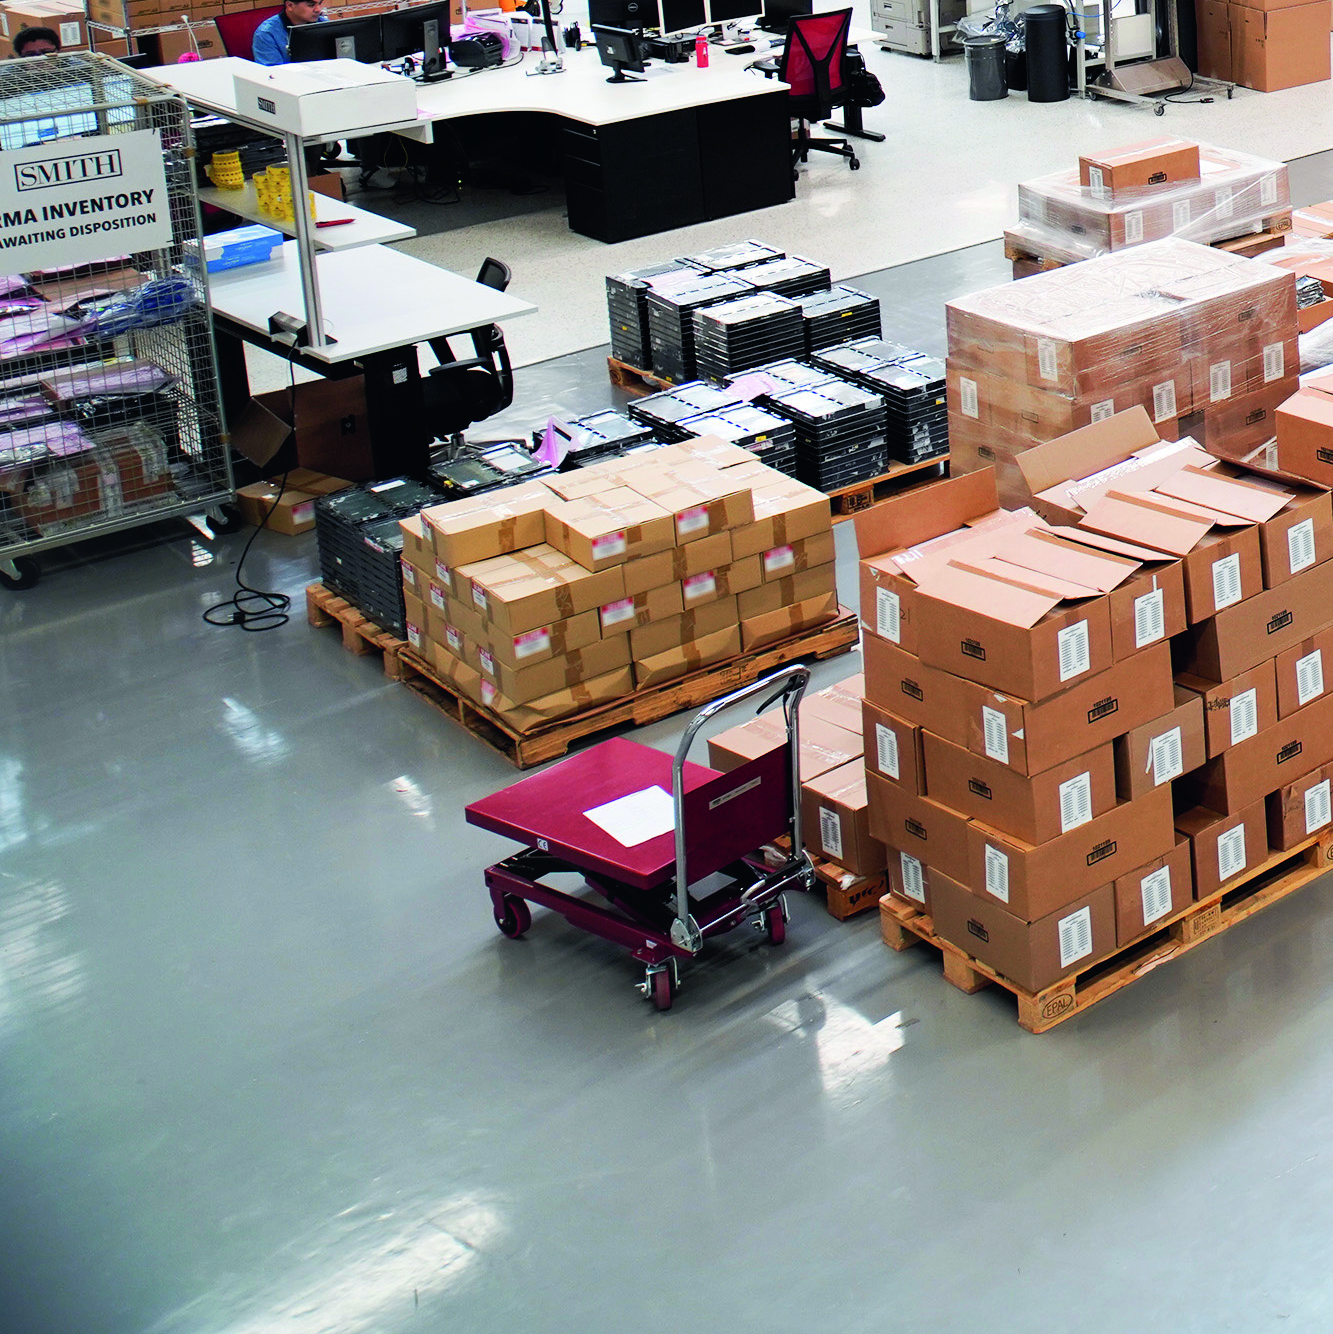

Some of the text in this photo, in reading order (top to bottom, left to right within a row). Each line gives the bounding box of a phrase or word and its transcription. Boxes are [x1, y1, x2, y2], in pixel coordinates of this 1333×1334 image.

[19, 153, 118, 187] SMITH
[41, 189, 154, 220] INVENTORY
[69, 213, 157, 238] DISPOSITION
